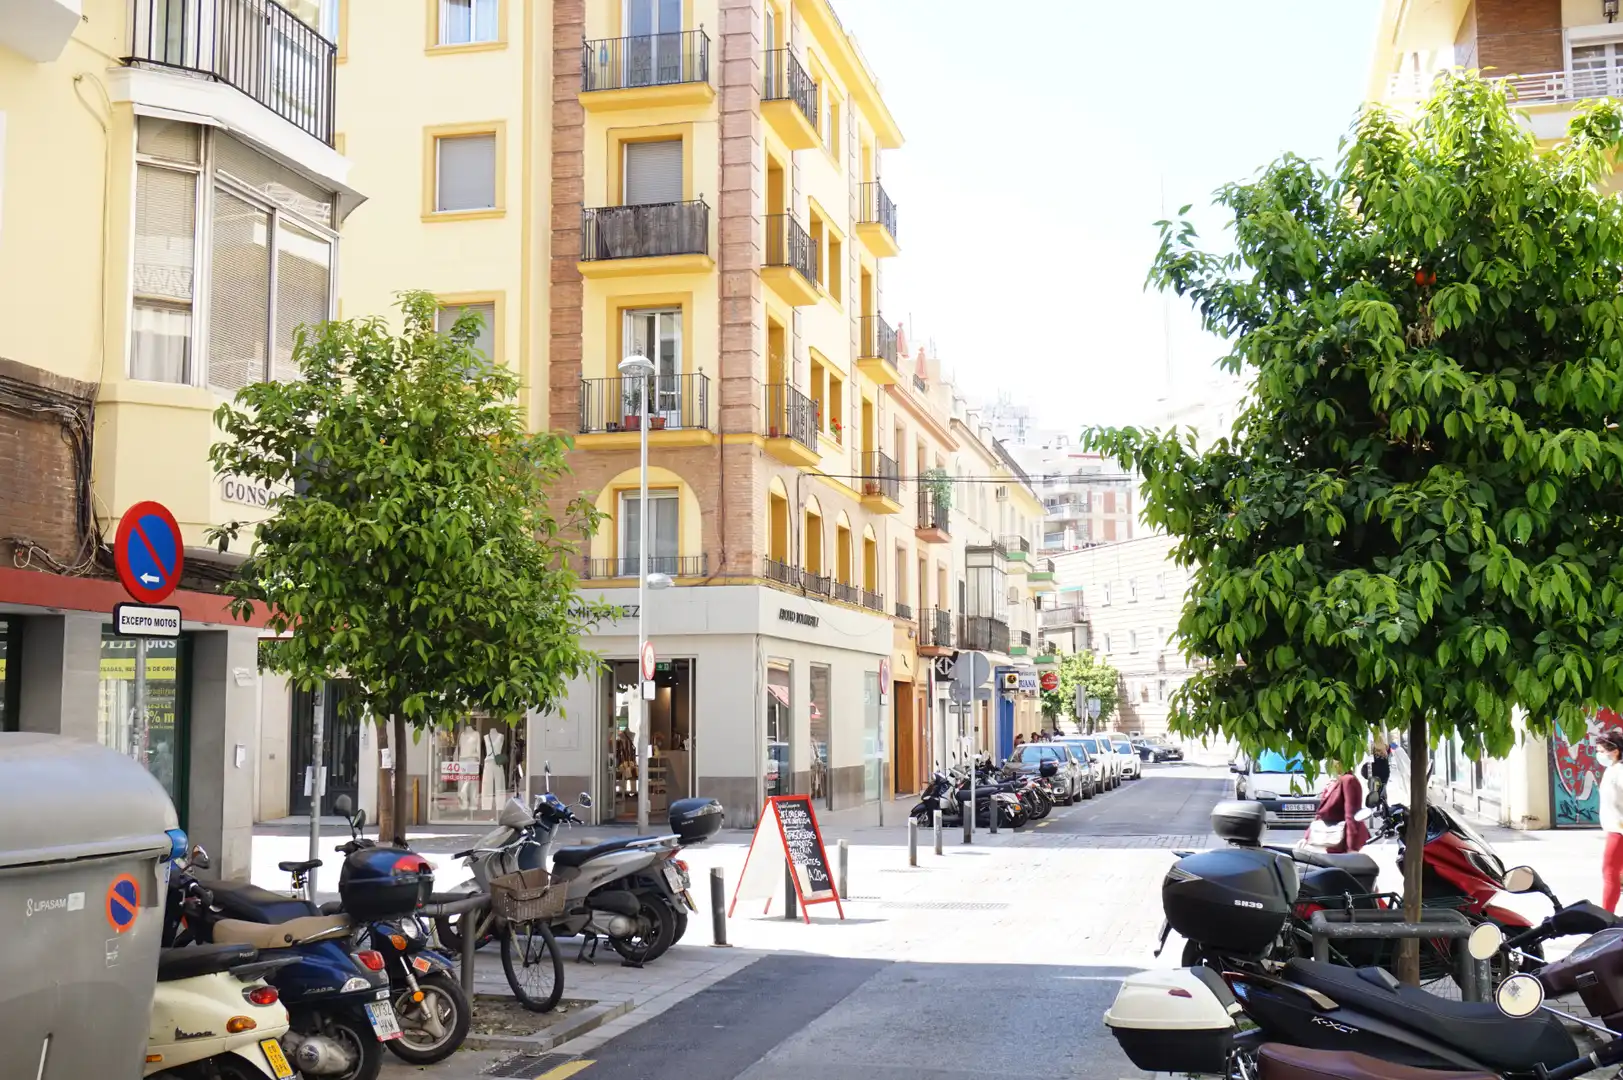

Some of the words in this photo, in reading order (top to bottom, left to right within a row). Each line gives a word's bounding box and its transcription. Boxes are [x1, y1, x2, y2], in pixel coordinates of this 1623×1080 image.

[121, 615, 152, 626] EXCEPTO
[153, 618, 177, 628] MOTOS
[33, 898, 67, 912] LIPASAM
